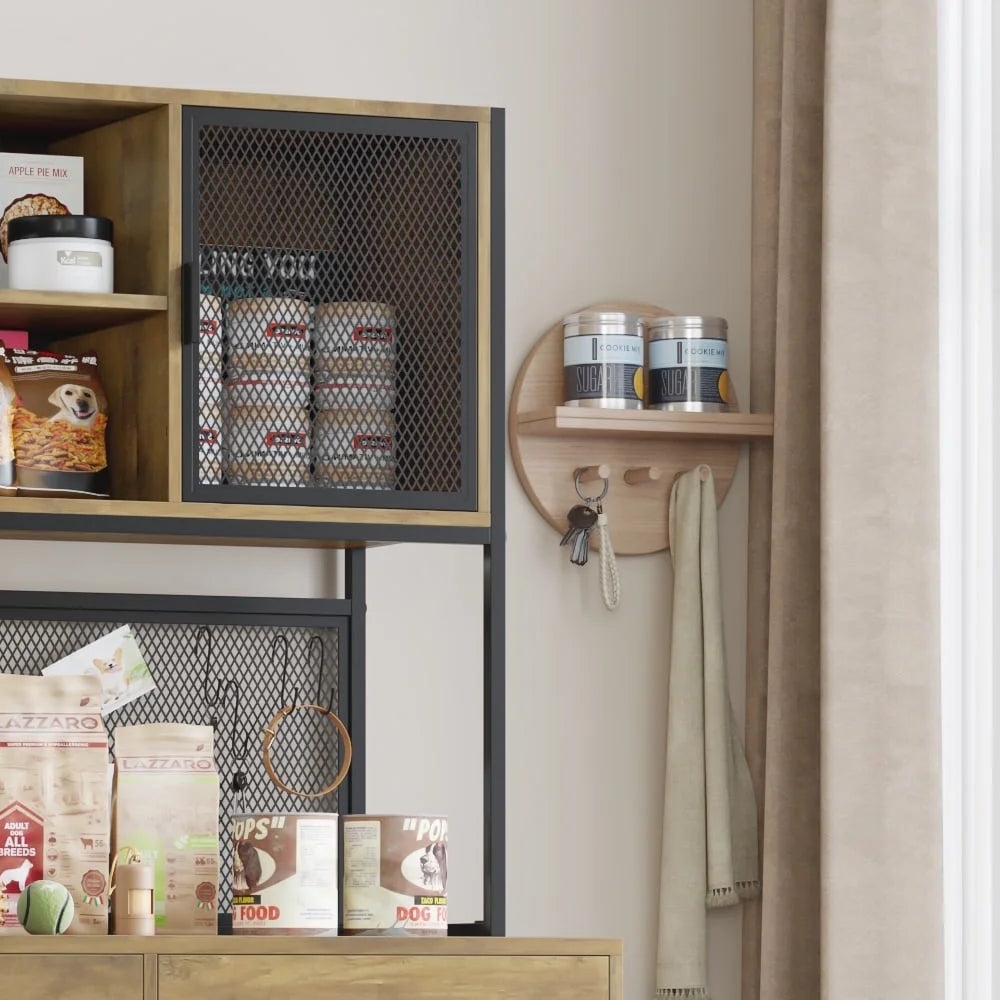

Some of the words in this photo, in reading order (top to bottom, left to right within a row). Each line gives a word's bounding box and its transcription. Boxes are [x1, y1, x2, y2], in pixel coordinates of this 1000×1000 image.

[8, 166, 34, 176] APPLE
[37, 167, 50, 177] PIE
[52, 168, 68, 178] MIX
[263, 252, 316, 280] YOU
[599, 344, 630, 353] COOKIE
[684, 348, 716, 357] COOKIE
[123, 759, 212, 770] LAZZARO
[4, 822, 29, 830] ADULT
[4, 836, 29, 847] ALL
[240, 905, 280, 921] FOOD
[396, 906, 431, 922] DOG
